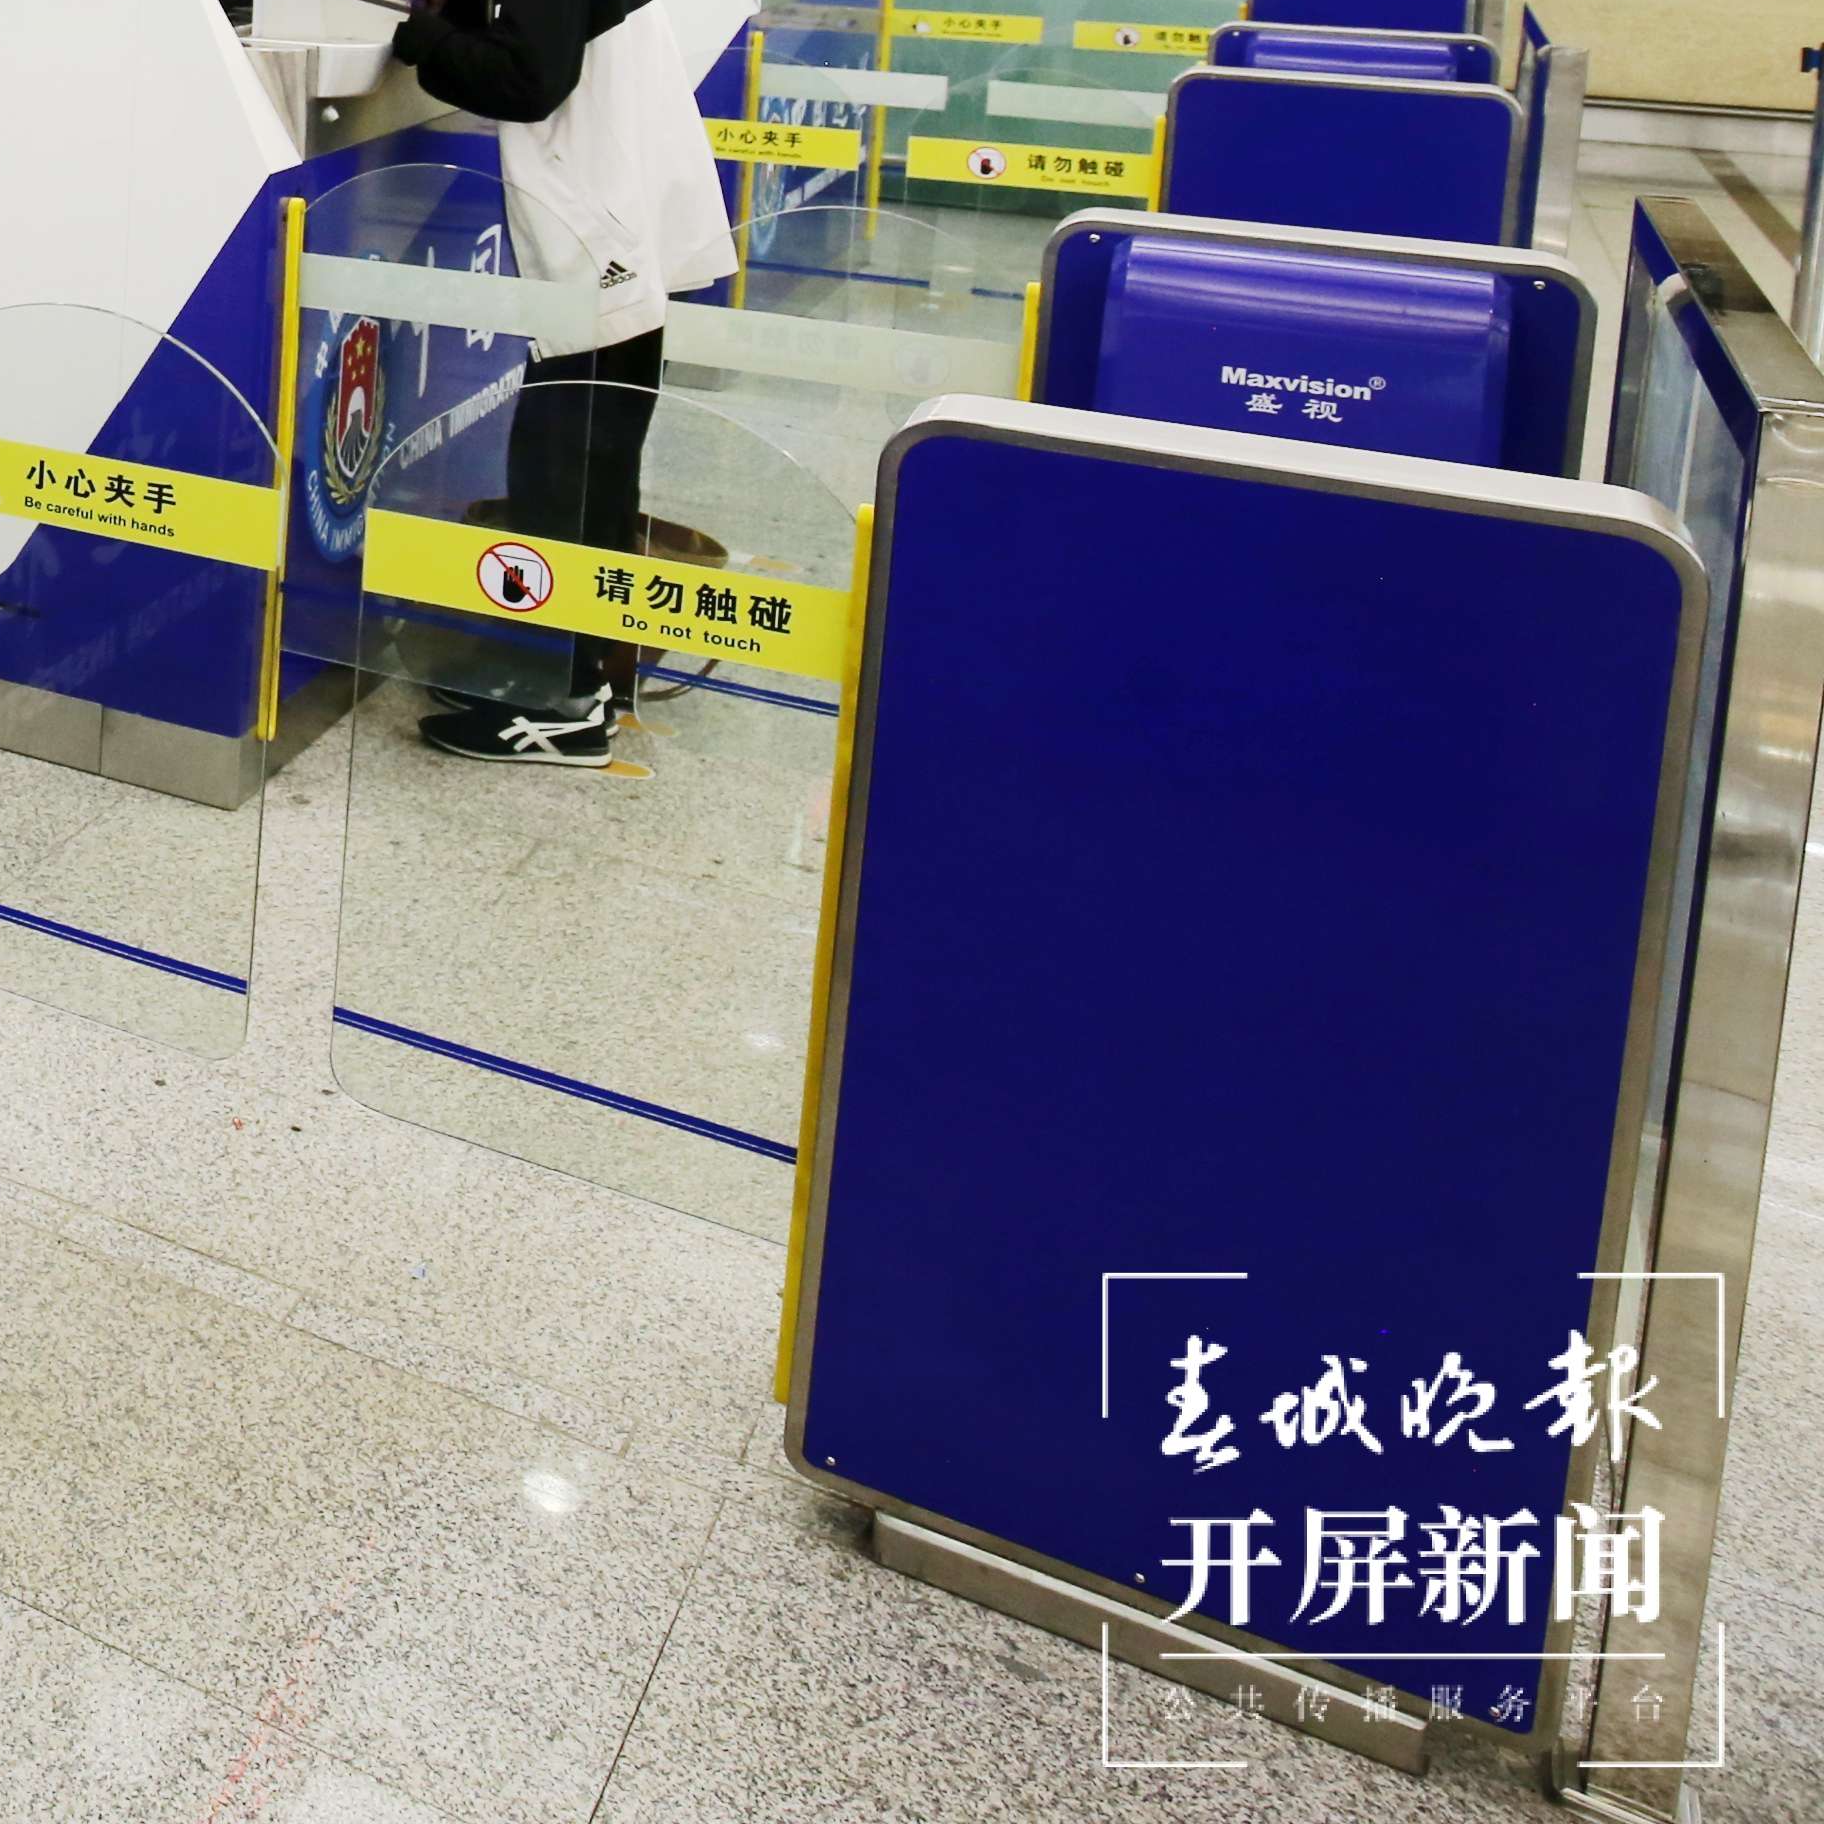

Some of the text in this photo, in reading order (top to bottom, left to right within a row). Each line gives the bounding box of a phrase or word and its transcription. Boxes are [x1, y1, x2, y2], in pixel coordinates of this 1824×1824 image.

[717, 127, 804, 148] 小心夹手
[1027, 154, 1125, 178] 请勿触碰
[1244, 392, 1344, 424] 盛视
[26, 459, 177, 514] 小心夹手
[24, 495, 176, 538] Be careful with hands
[594, 565, 792, 635] 请勿触碰
[621, 613, 762, 653] Do not touch
